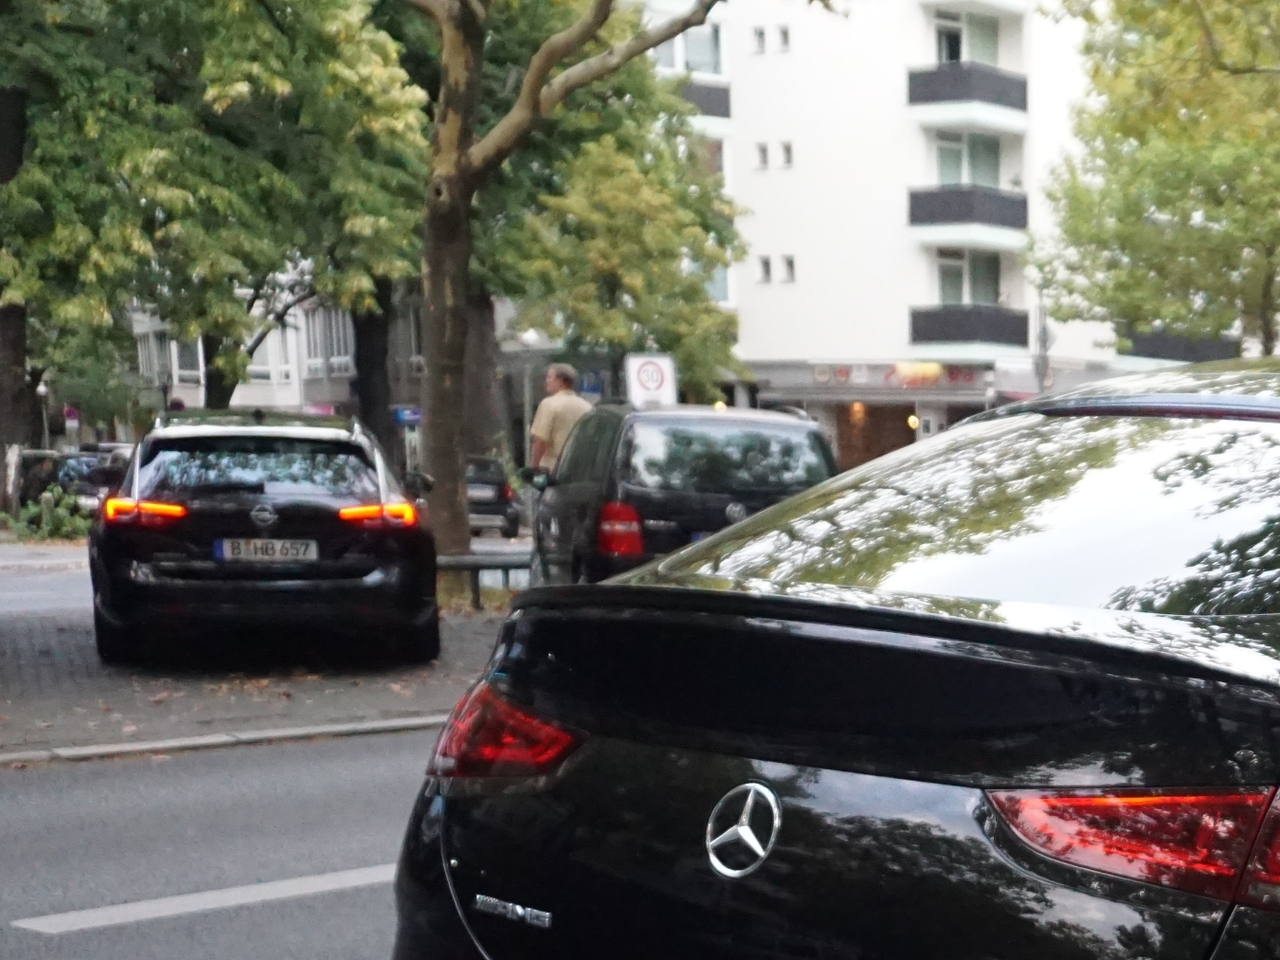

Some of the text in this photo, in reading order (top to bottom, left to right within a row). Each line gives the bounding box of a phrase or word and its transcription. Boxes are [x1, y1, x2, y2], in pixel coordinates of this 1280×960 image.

[642, 369, 659, 384] 30
[230, 541, 241, 556] B
[493, 900, 552, 928] AMG
